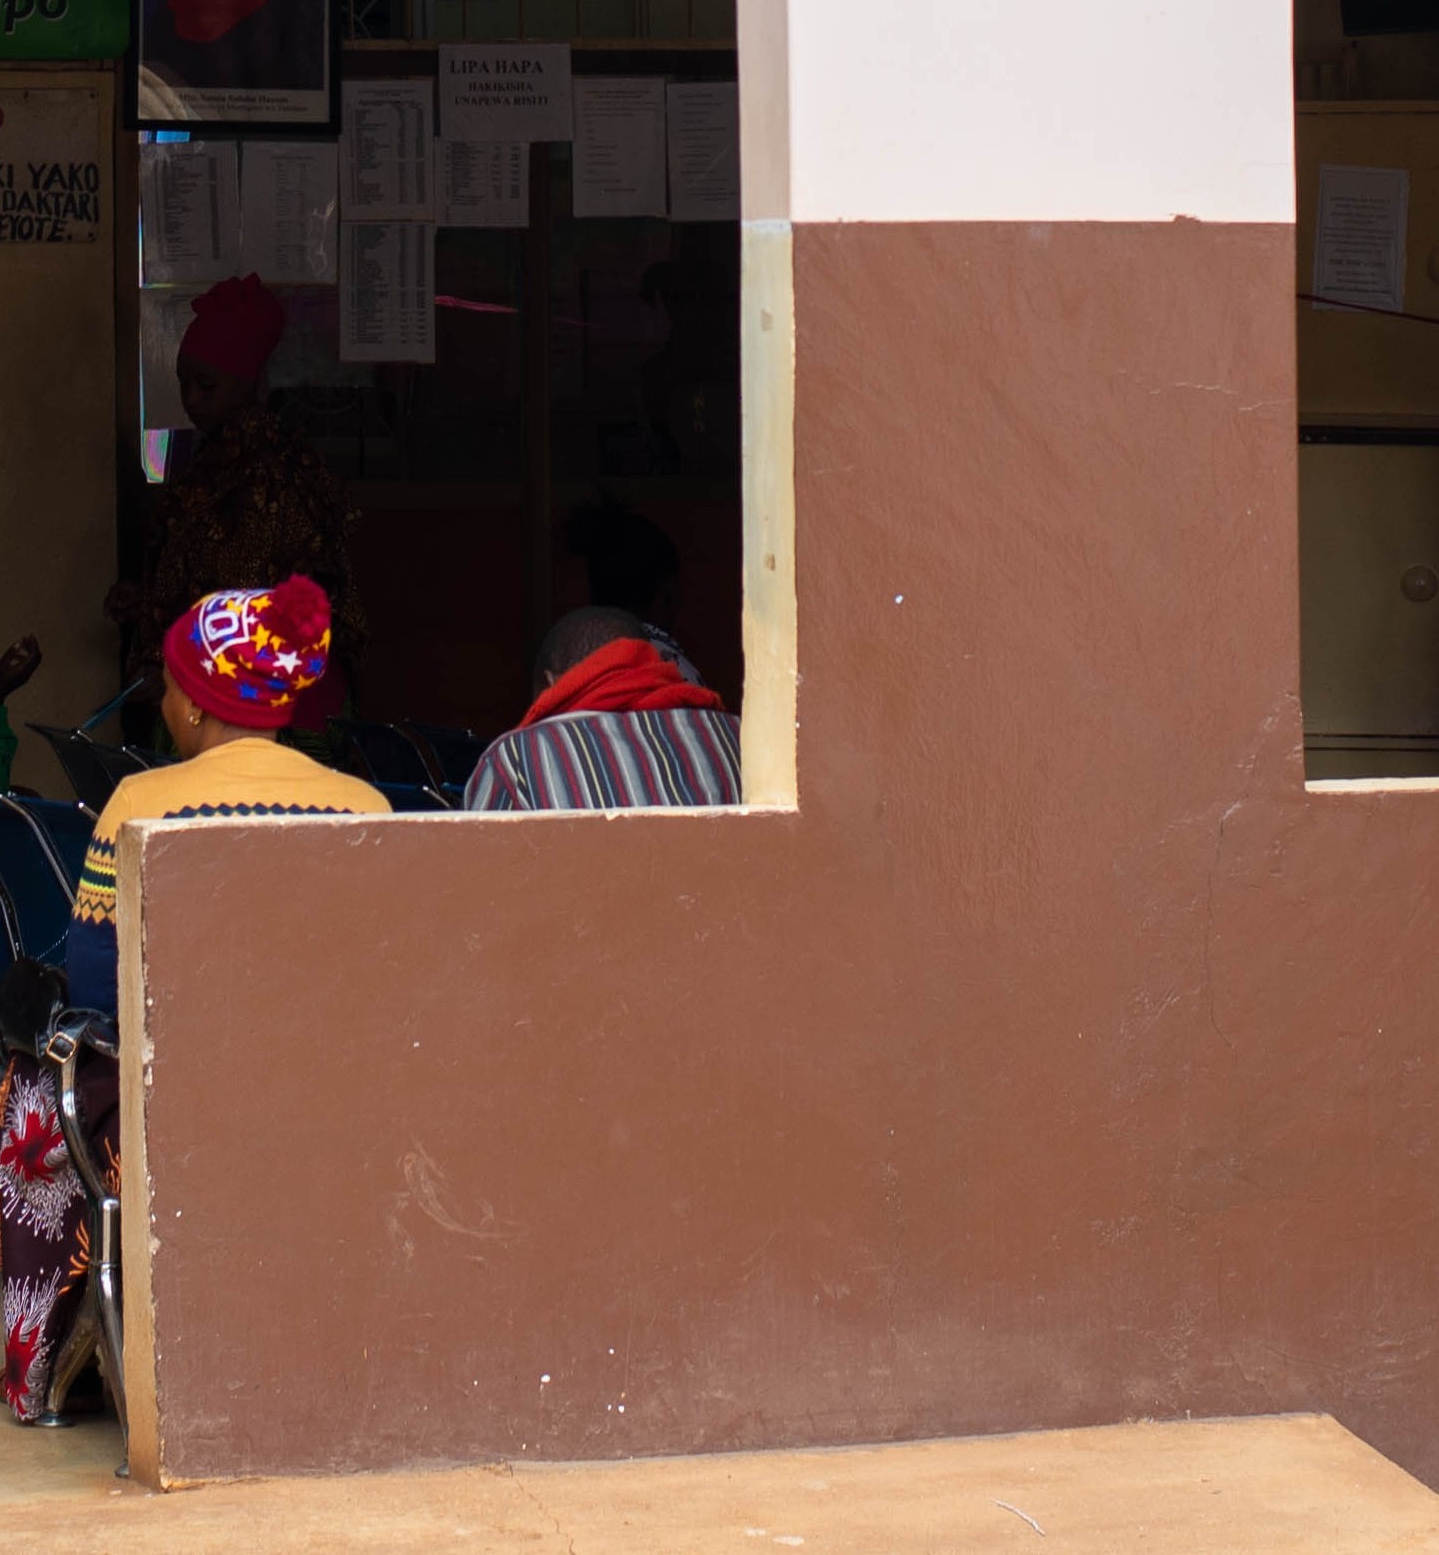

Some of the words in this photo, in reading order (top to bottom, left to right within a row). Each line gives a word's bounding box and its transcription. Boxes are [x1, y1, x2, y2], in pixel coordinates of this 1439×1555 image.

[450, 59, 490, 74] LIPA
[495, 59, 544, 74] HAPA
[28, 163, 100, 194] YAKO
[3, 190, 99, 225] DAKTARI
